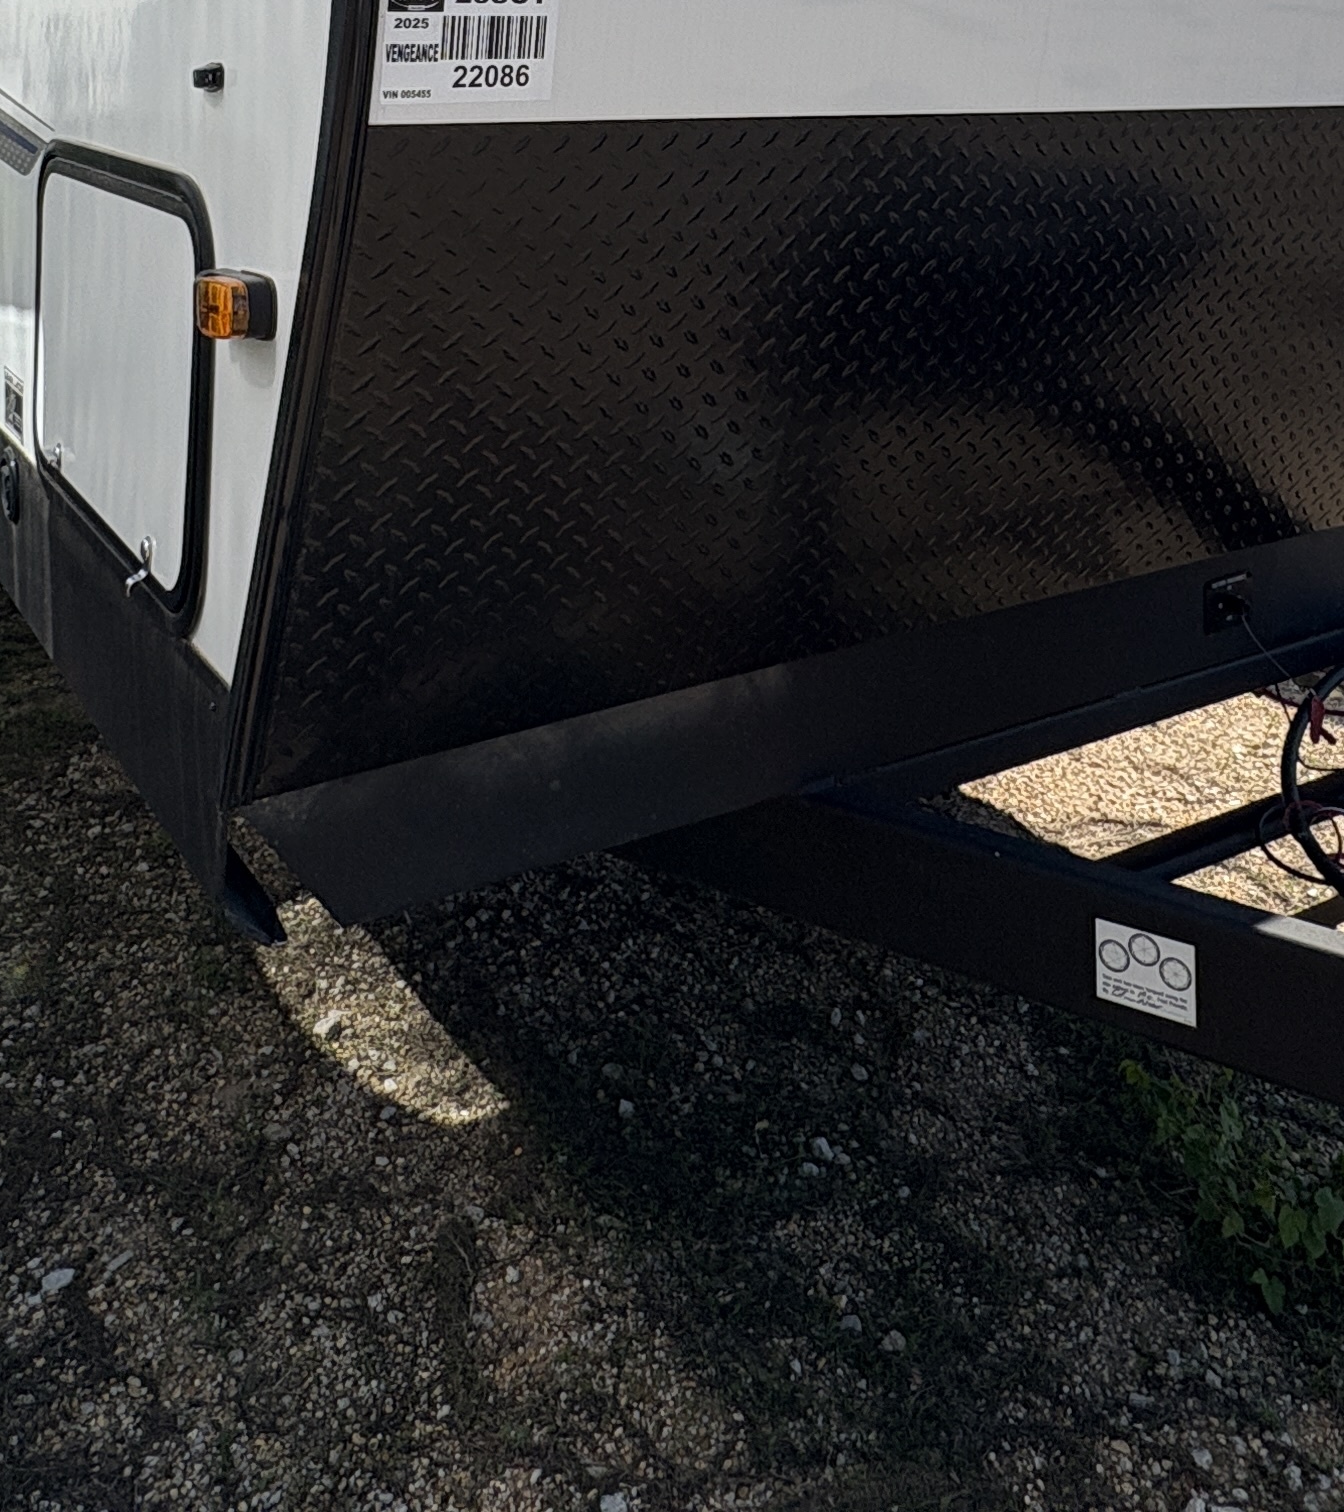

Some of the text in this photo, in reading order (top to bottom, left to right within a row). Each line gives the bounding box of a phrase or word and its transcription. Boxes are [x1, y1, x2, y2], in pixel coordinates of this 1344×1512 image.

[393, 18, 430, 29] 2025
[385, 43, 439, 63] VENGEANCE
[452, 64, 530, 88] 22086
[382, 89, 399, 99] VIN
